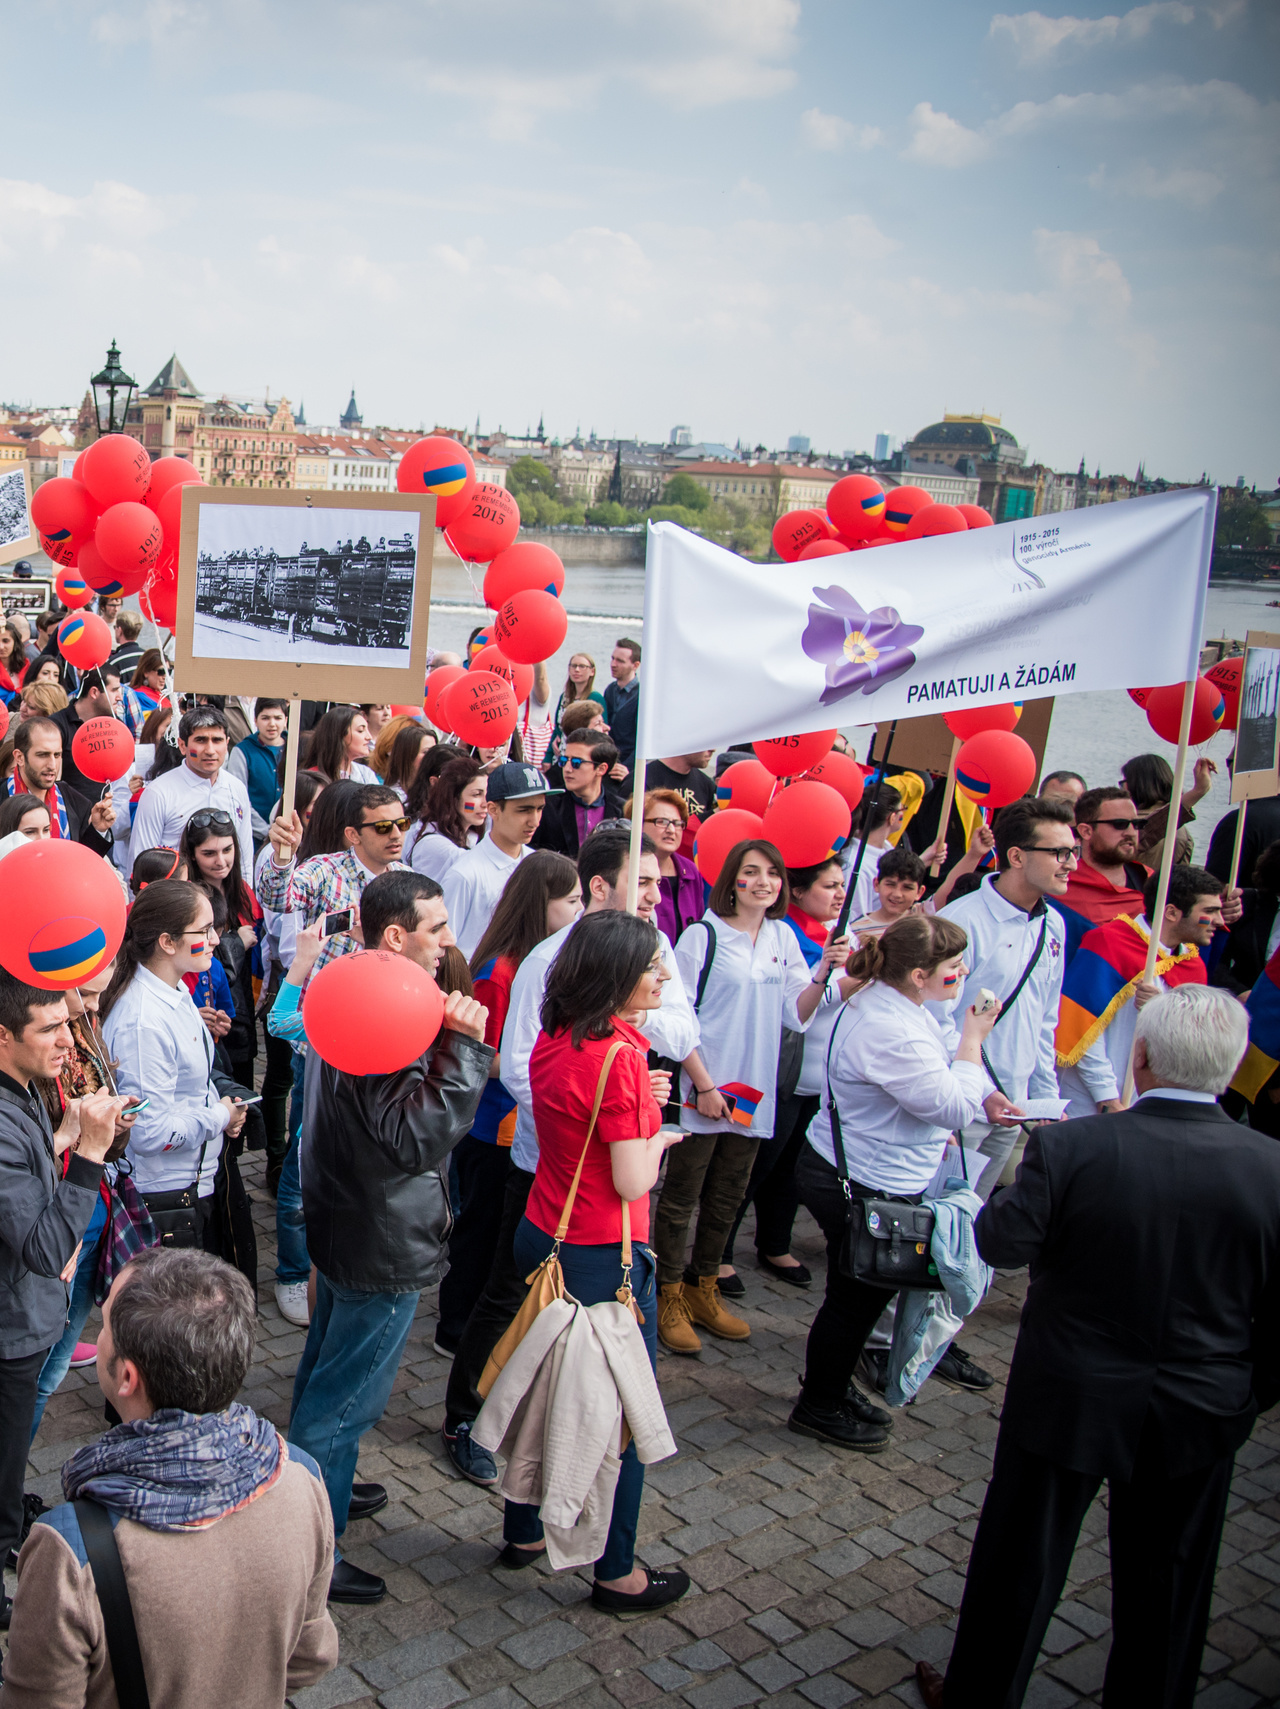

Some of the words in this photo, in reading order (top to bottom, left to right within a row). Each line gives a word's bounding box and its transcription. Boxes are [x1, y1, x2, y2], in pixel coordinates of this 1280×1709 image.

[482, 485, 511, 503] 1915
[481, 495, 514, 516] REMEMBER
[472, 504, 506, 525] 2015
[138, 525, 160, 554] 1915
[791, 522, 814, 542] 1915
[1020, 532, 1037, 543] 1915
[1042, 527, 1060, 538] 2015
[1019, 544, 1035, 554] 100.
[1035, 538, 1059, 551] výročí
[1022, 550, 1059, 564] genocidy
[503, 601, 519, 627] 1915
[495, 627, 504, 642] 15
[489, 664, 516, 681] 1915
[1210, 666, 1239, 682] 1915
[470, 680, 501, 699] 1915
[906, 673, 994, 704] PAMATUJI
[998, 672, 1011, 691] A
[1014, 660, 1077, 689] ŽÁDÁM
[468, 702, 481, 712] WE
[479, 692, 511, 708] REMEMBER
[1133, 689, 1146, 703] 15
[481, 703, 510, 724] 2015
[86, 720, 111, 732] 1915
[88, 730, 119, 740] REMEMBER
[87, 738, 115, 754] 2015
[522, 767, 543, 788] M
[808, 764, 825, 775] 15
